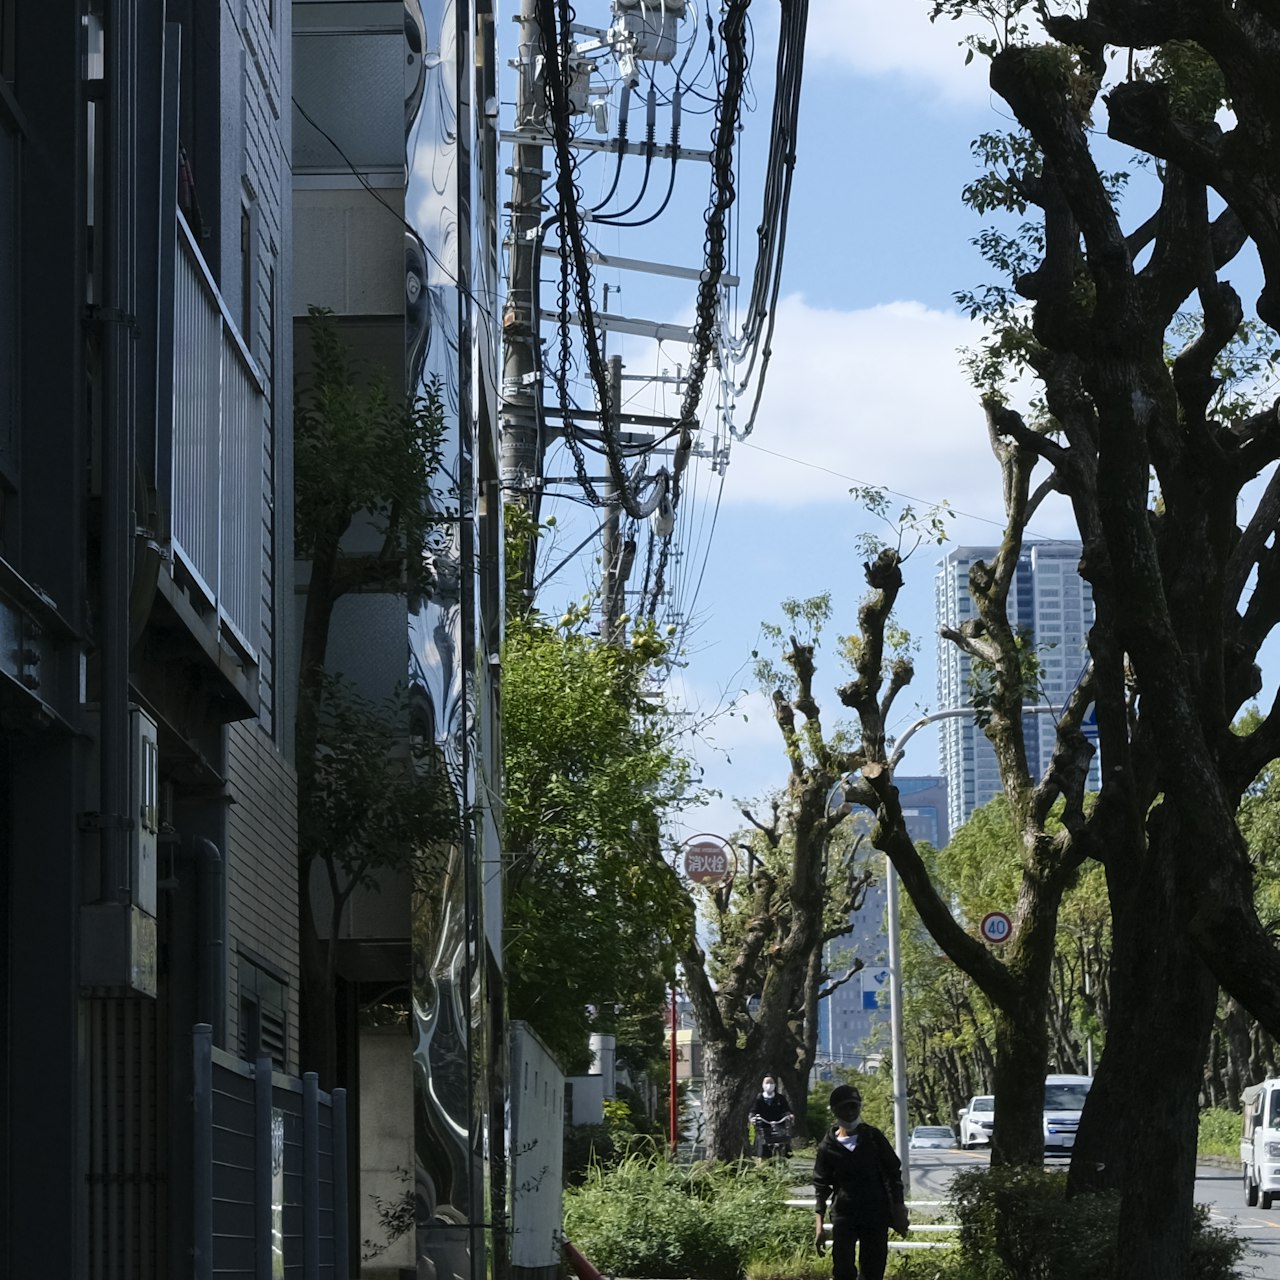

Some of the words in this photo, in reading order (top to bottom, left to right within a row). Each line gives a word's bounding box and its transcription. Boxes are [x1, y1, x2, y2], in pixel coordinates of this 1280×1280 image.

[688, 855, 725, 872] 消火栓
[988, 920, 1005, 935] 40
